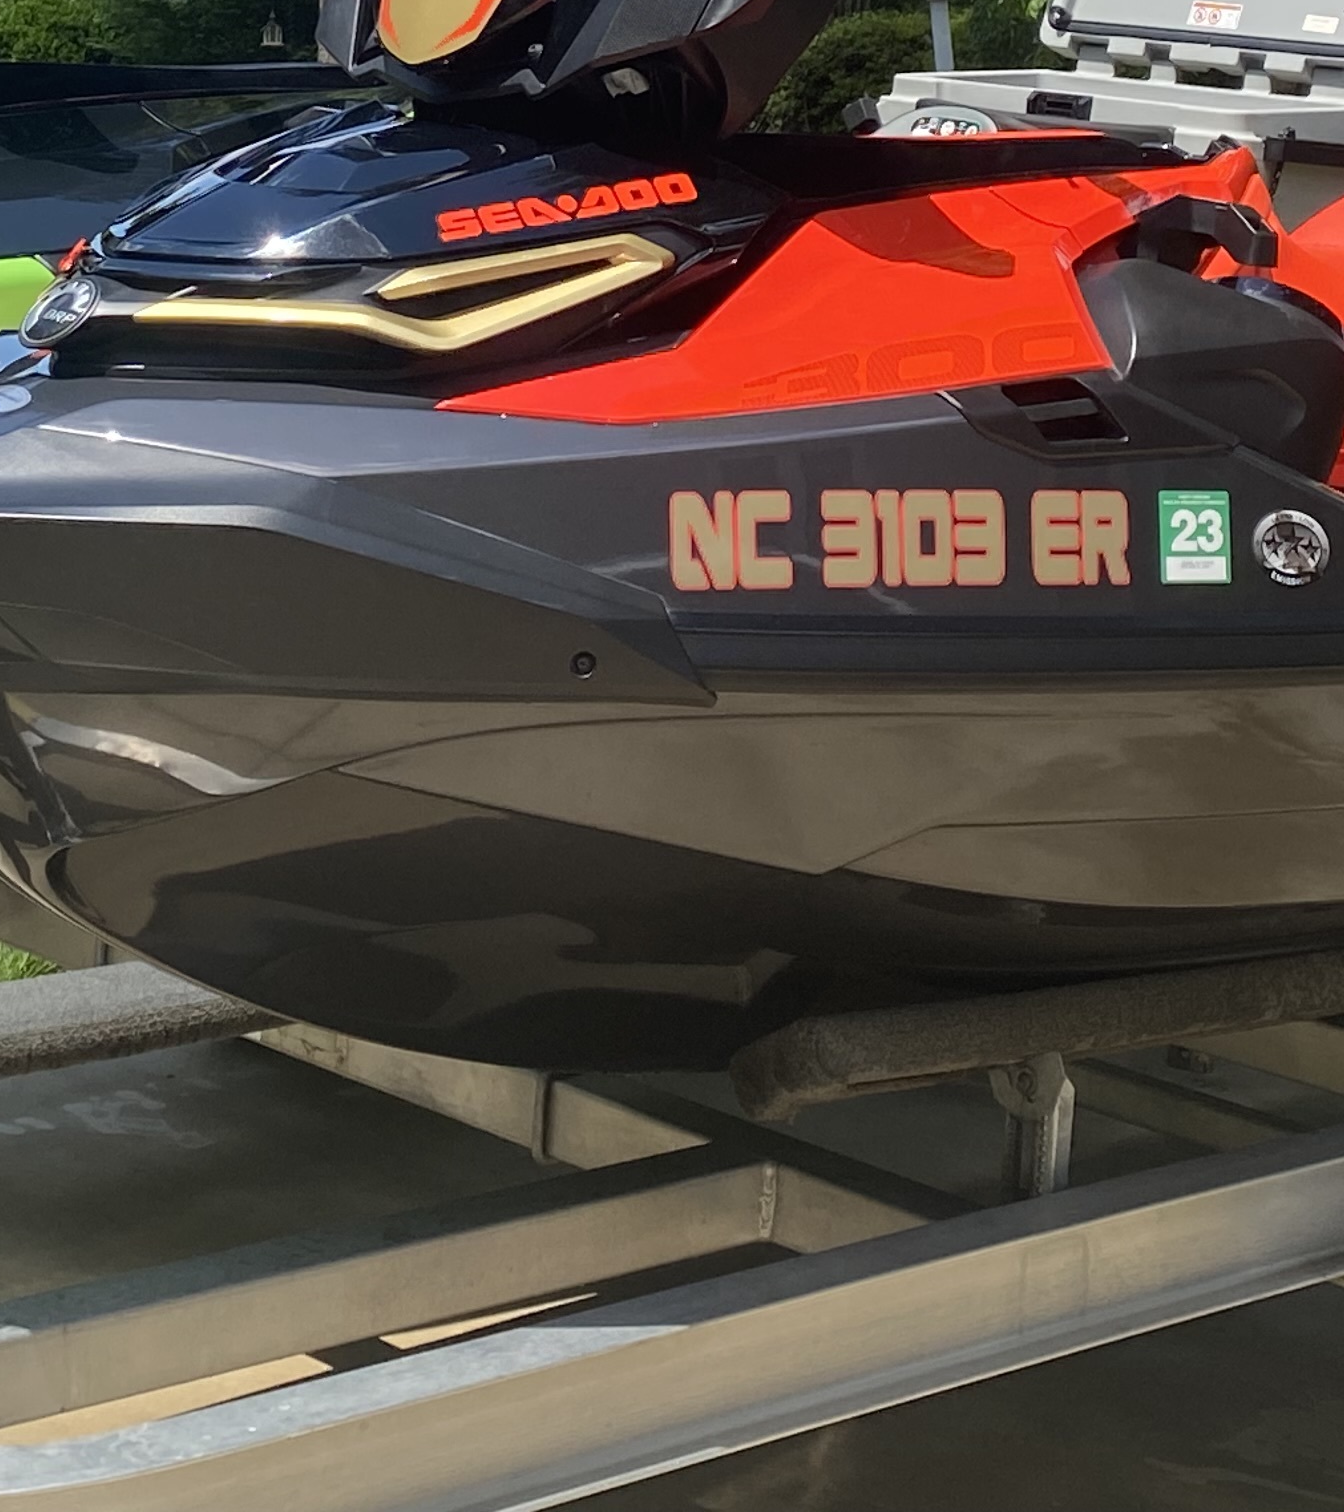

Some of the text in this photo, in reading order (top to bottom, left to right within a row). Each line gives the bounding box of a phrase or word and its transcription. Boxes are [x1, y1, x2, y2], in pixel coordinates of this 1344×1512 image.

[669, 489, 1131, 591] NC 3103 ER
[1170, 508, 1224, 553] 23
